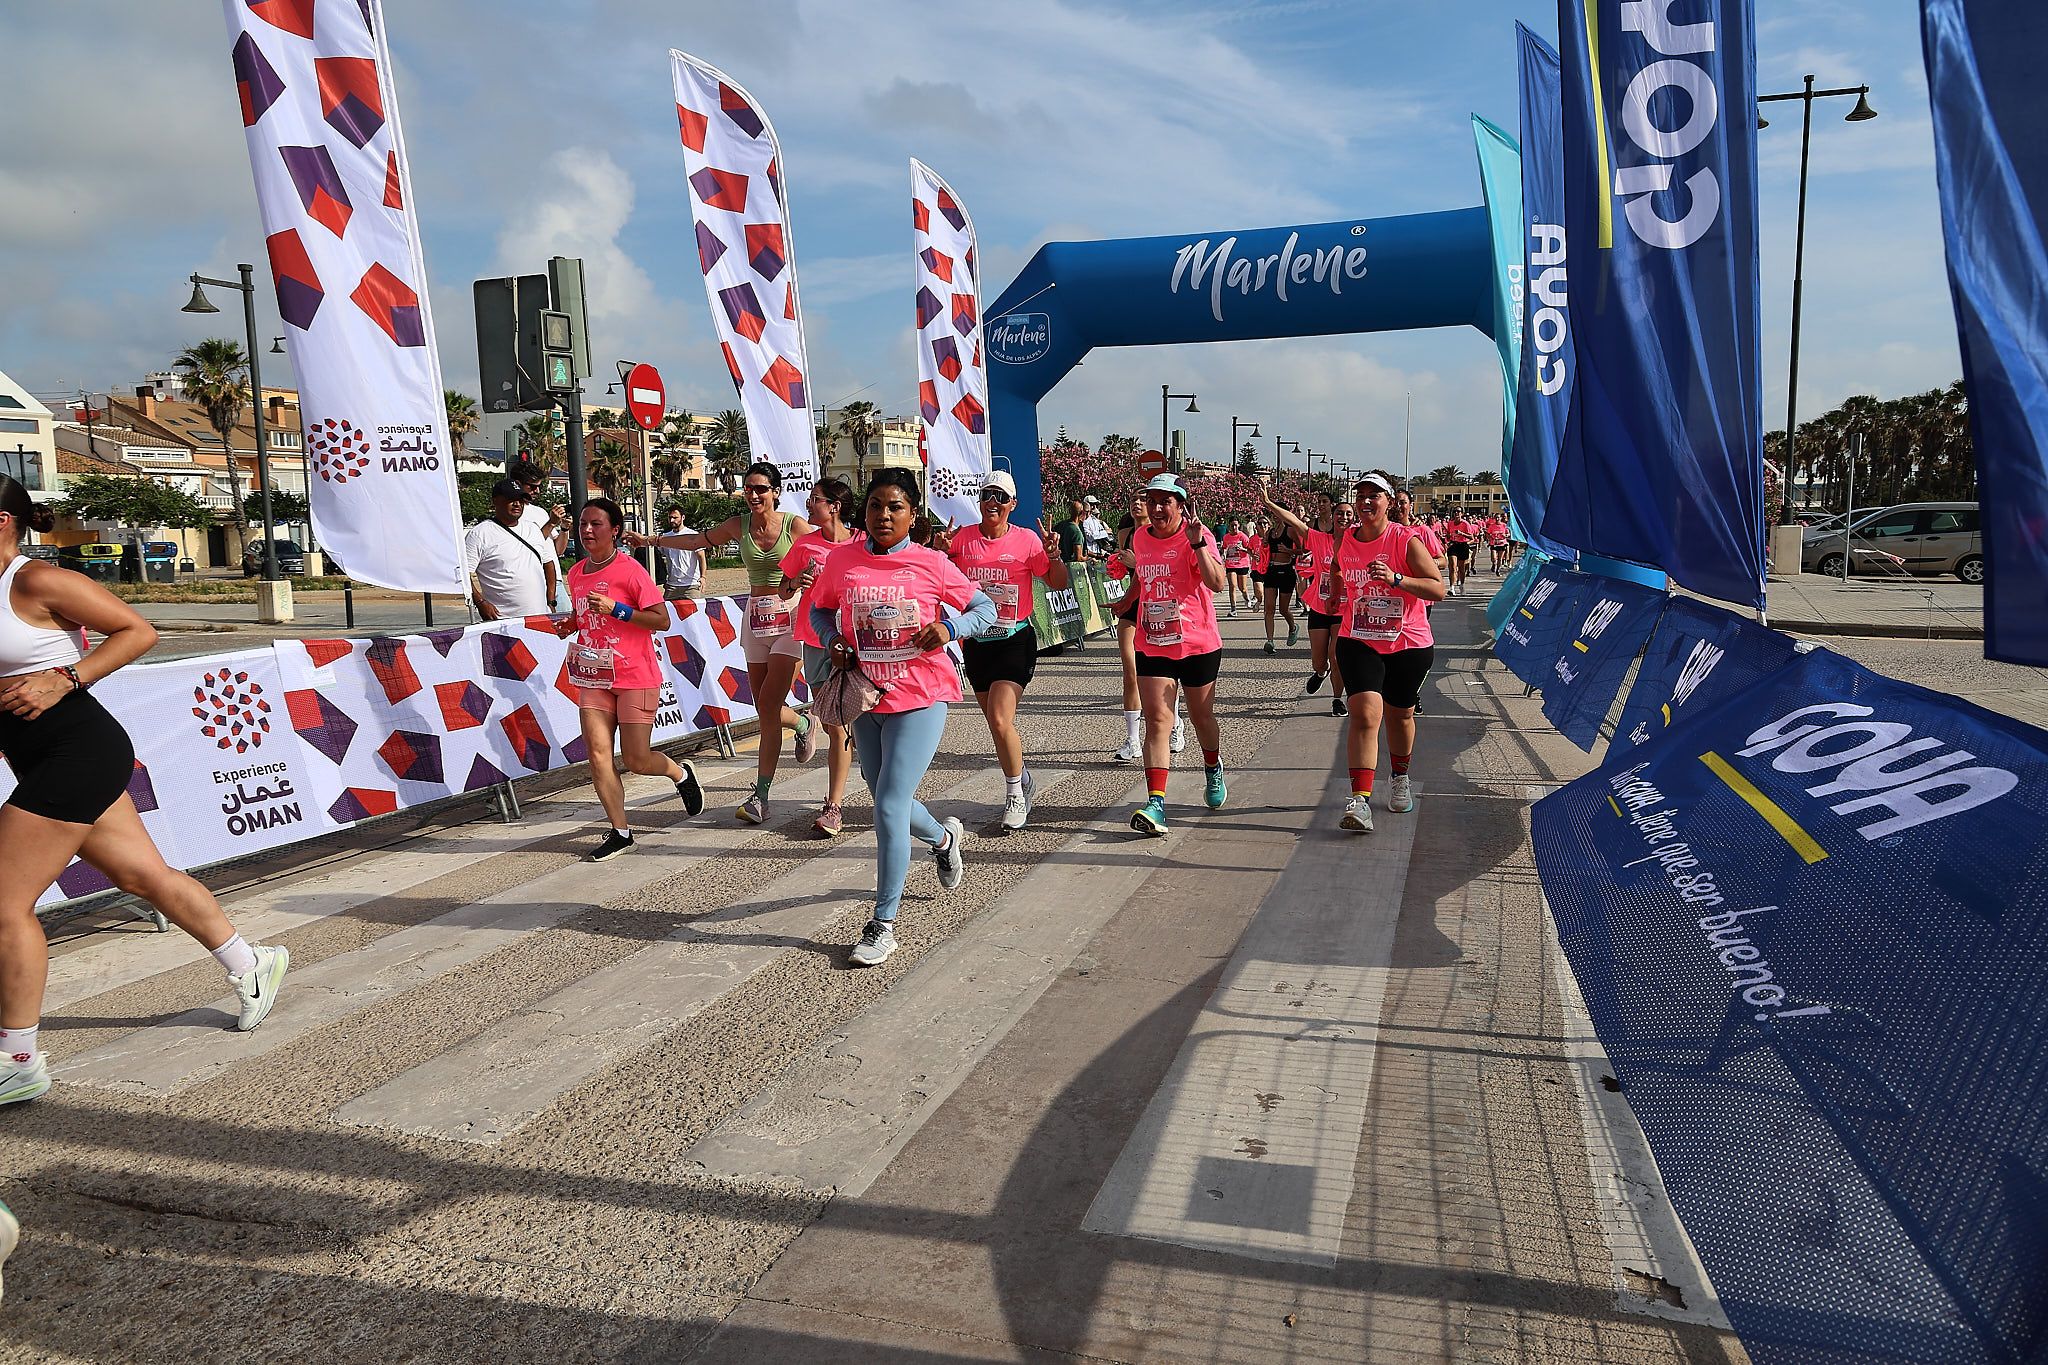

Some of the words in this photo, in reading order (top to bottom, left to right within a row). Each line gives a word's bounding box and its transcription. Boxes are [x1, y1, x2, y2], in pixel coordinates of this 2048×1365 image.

[1170, 231, 1368, 322] Marlene
[991, 325, 1046, 351] Marlene
[967, 567, 1009, 581] CARRERA
[1346, 570, 1370, 581] CARR
[846, 585, 906, 604] CARRERA
[760, 613, 776, 622] 016
[1150, 621, 1166, 630] 016
[1368, 616, 1387, 625] 016
[875, 628, 900, 640] 016
[580, 666, 598, 675] 016
[654, 709, 683, 728] MAN
[213, 762, 287, 784] Experience
[1734, 702, 2019, 842] GOYA
[227, 802, 303, 836] OMAN
[1623, 842, 1698, 873] que
[1673, 872, 1724, 906] ser
[1699, 905, 1832, 1021] bueno!
